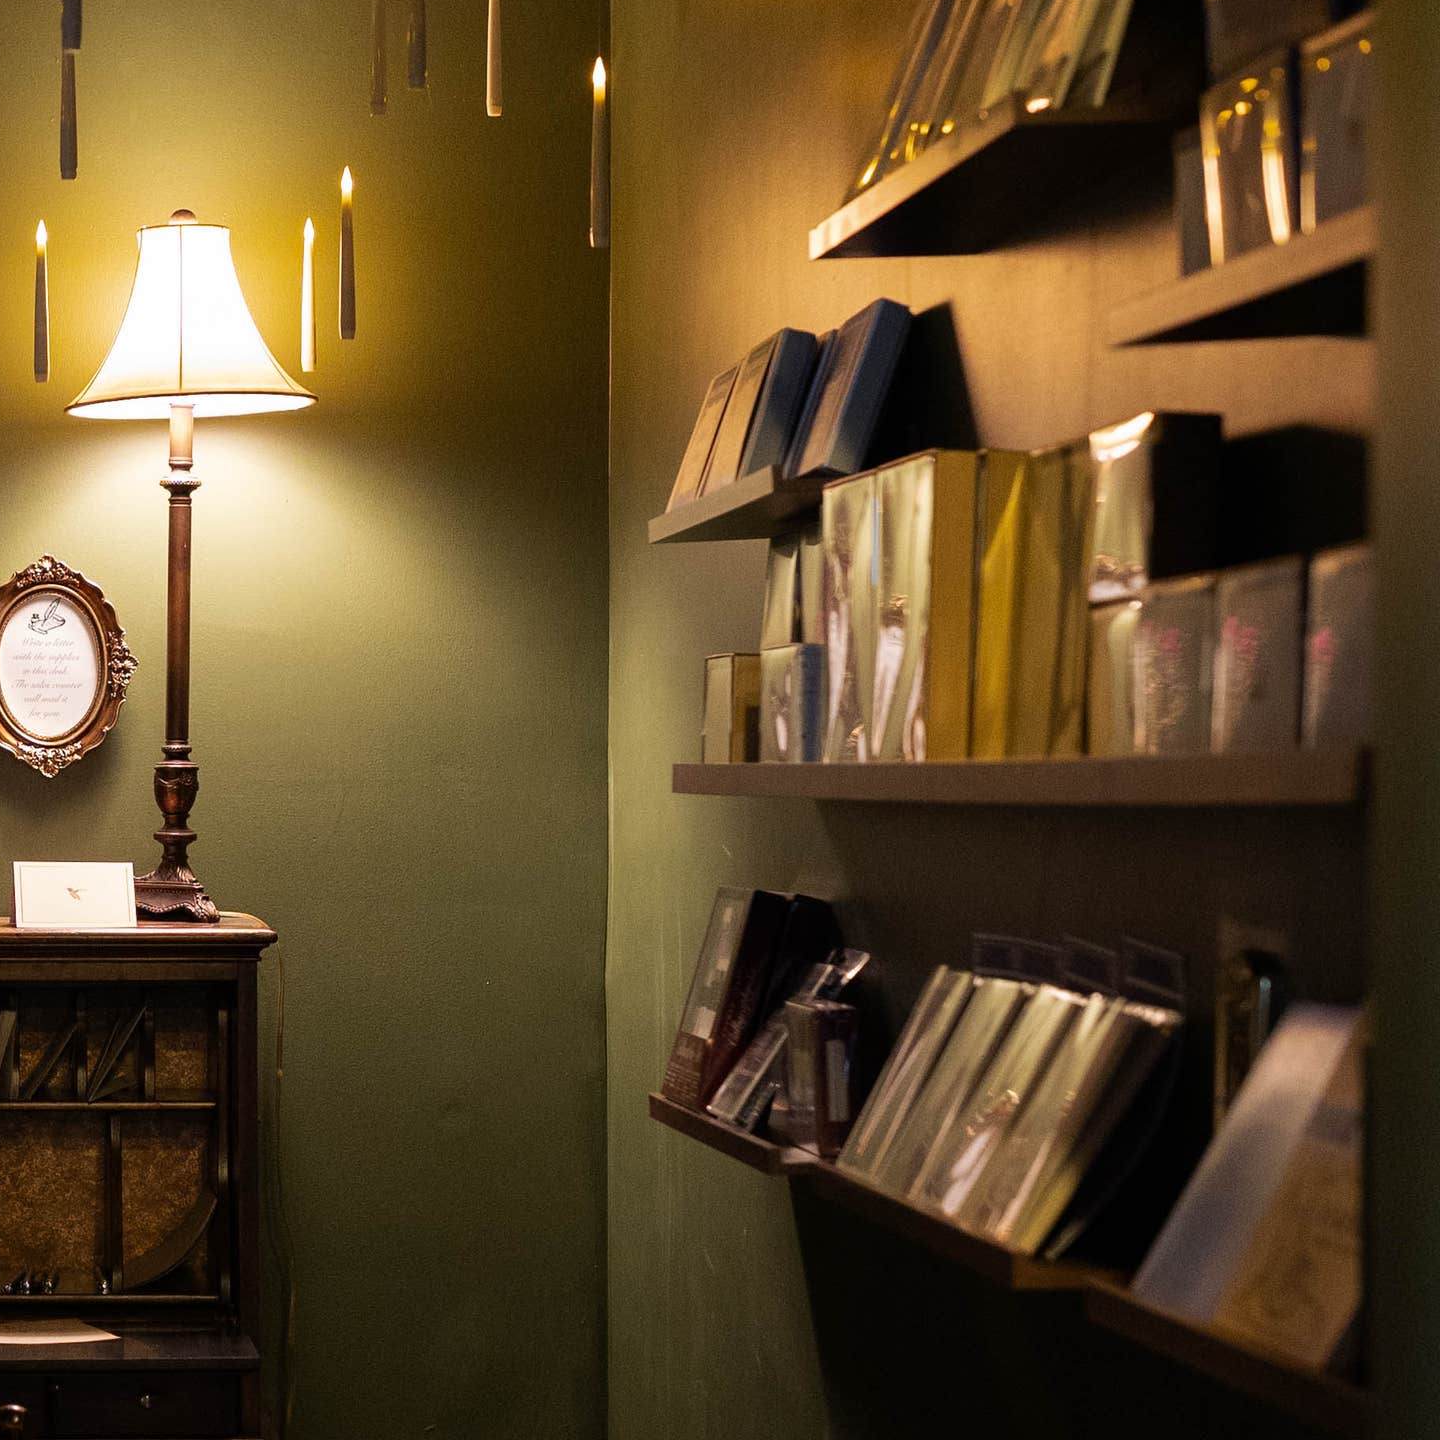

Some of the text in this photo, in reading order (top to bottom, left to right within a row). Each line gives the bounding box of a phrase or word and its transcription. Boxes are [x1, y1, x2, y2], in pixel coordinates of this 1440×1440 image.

[33, 651, 46, 660] the
[33, 665, 48, 675] this
[12, 679, 29, 689] The
